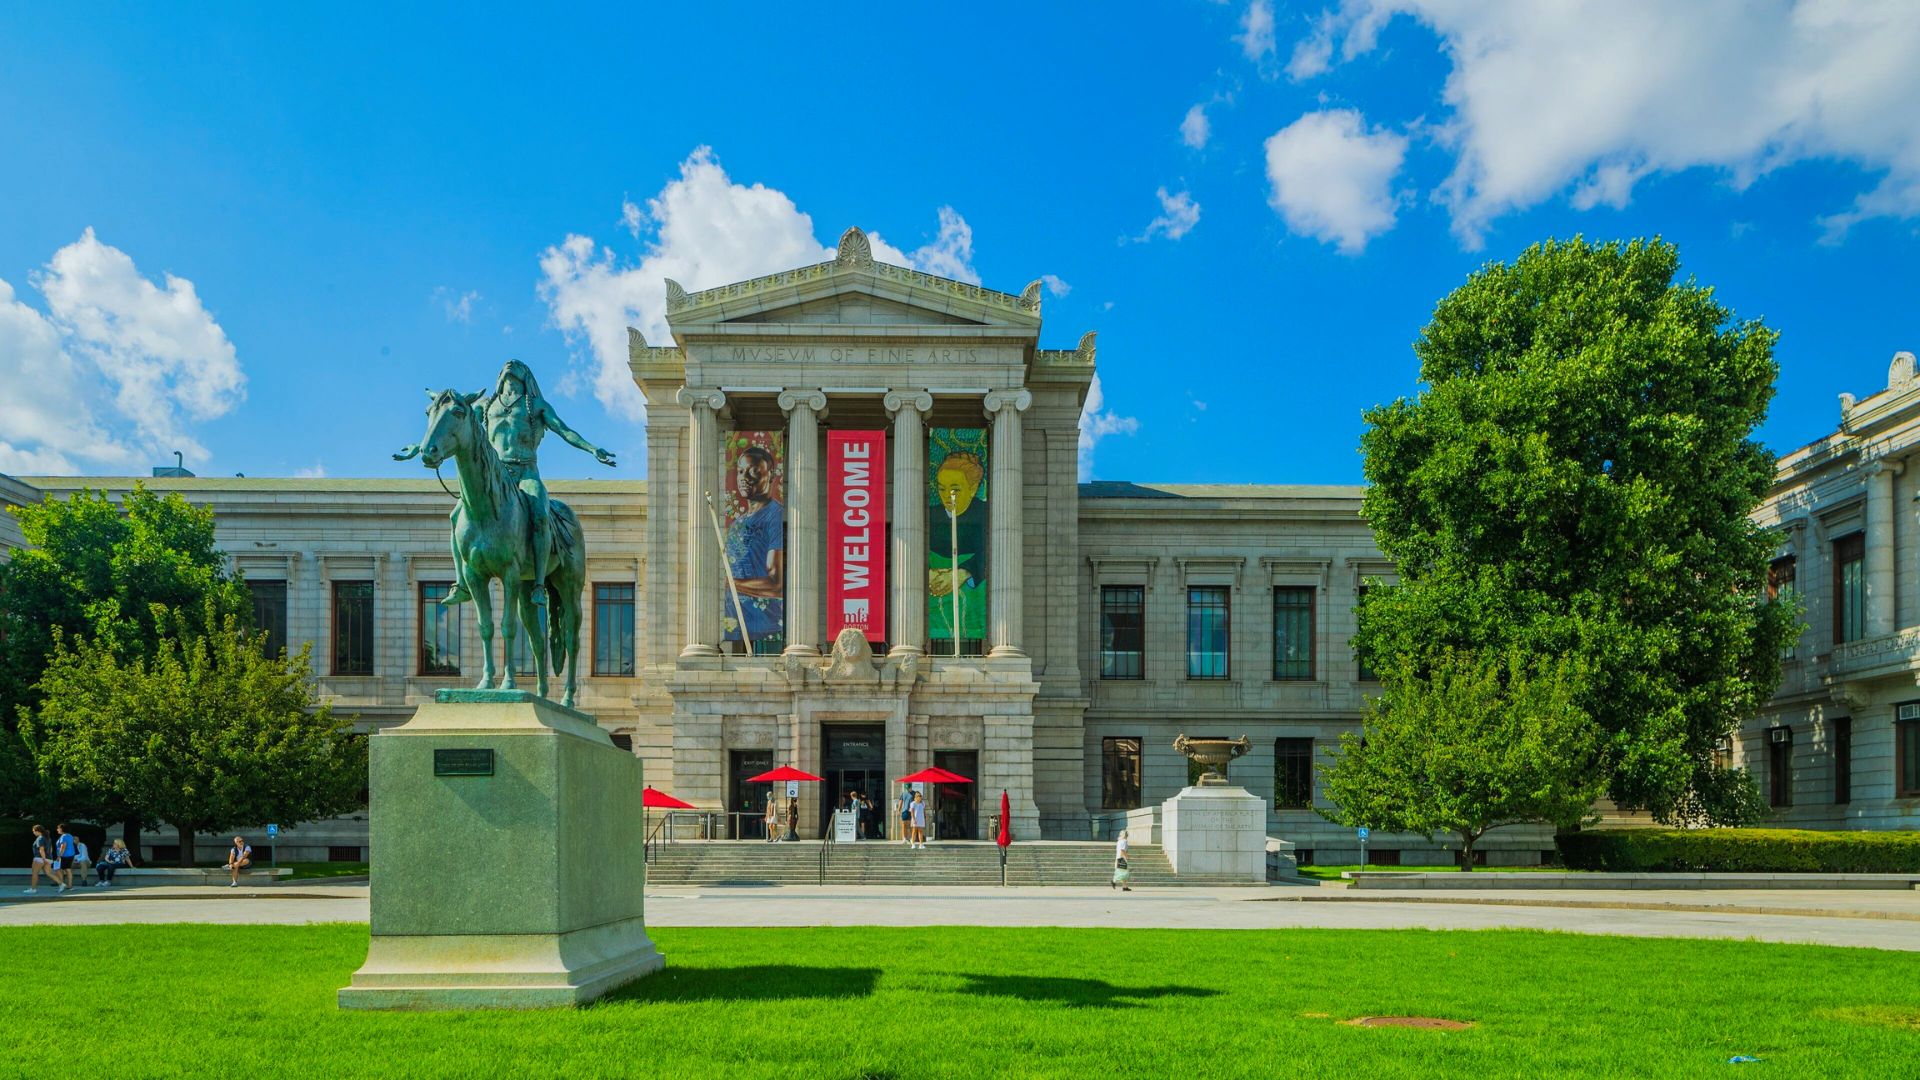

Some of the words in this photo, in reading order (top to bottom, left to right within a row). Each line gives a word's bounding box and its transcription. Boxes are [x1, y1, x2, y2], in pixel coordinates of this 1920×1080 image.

[733, 347, 816, 362] MVSEVM
[830, 348, 854, 362] OF
[869, 348, 914, 363] FINE
[927, 349, 977, 363] ARTS
[843, 442, 870, 591] WELCOME
[844, 607, 868, 623] mfa
